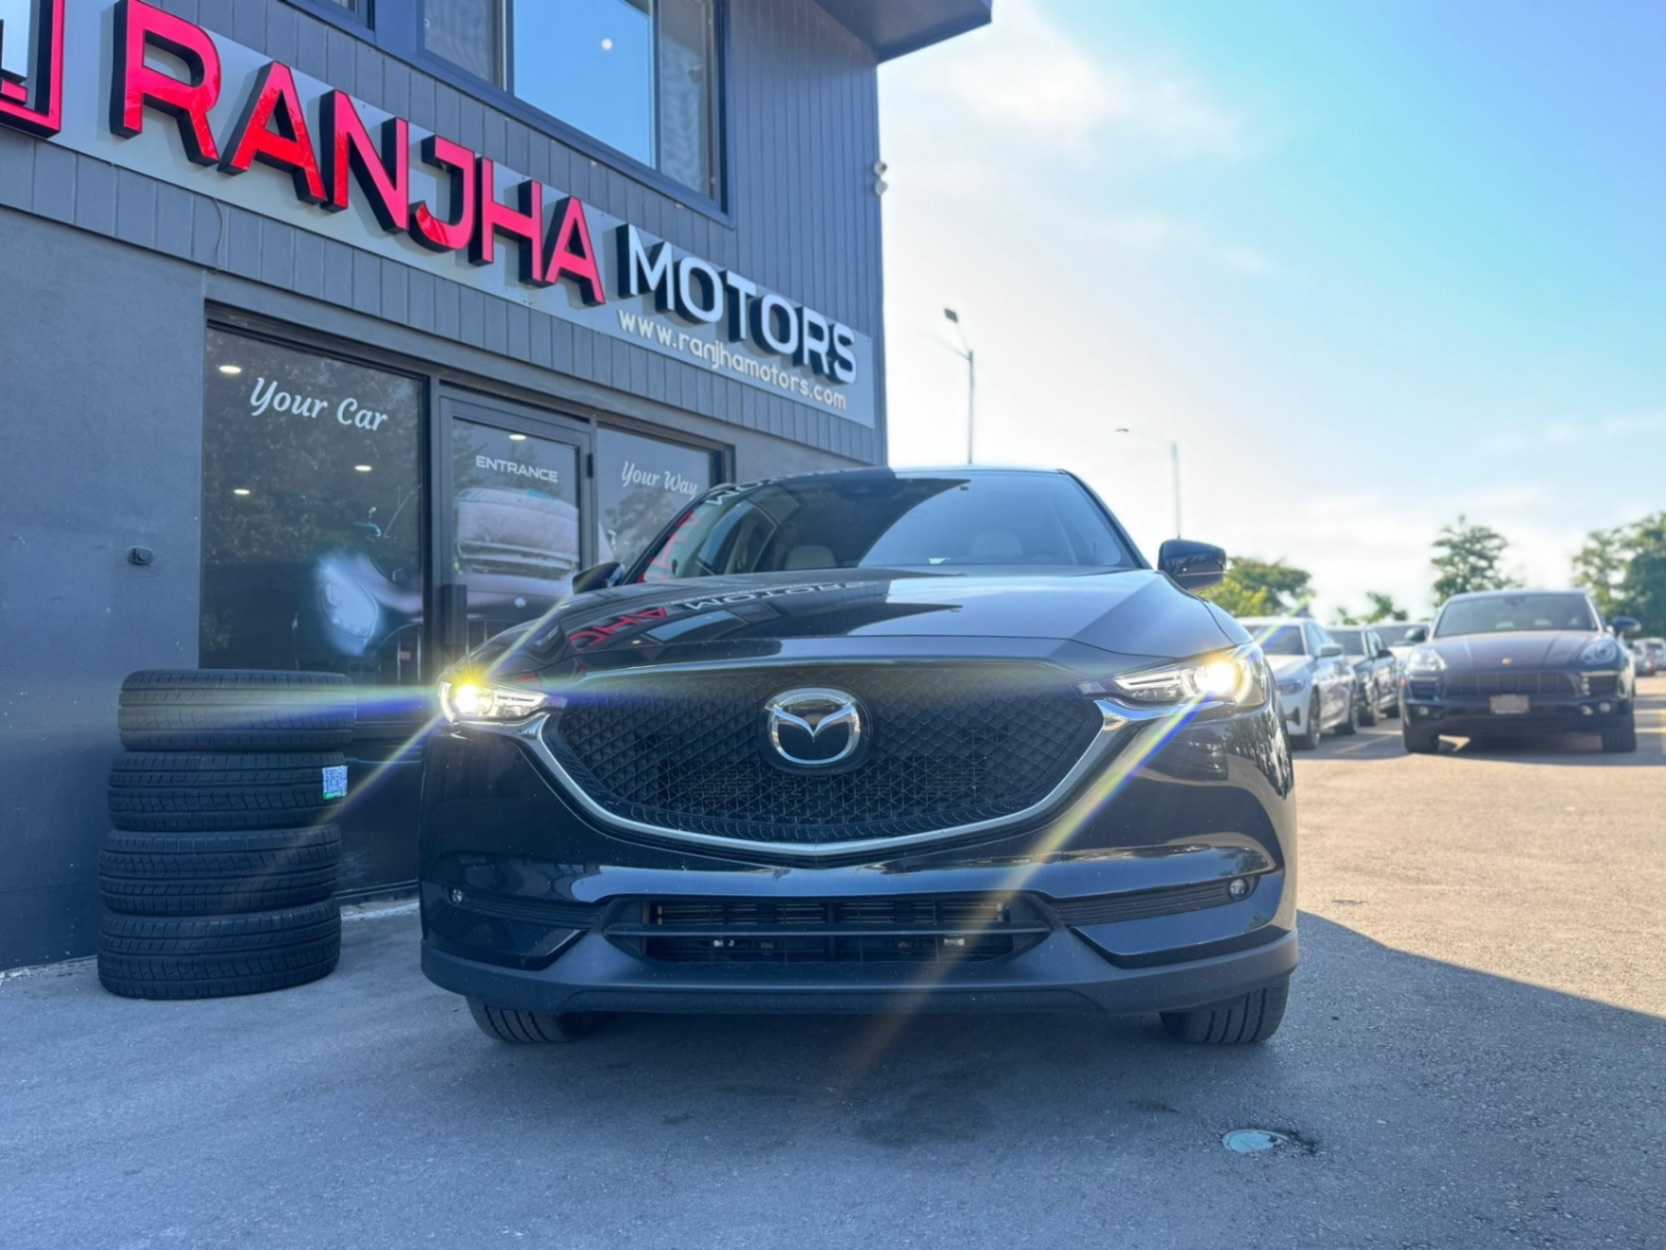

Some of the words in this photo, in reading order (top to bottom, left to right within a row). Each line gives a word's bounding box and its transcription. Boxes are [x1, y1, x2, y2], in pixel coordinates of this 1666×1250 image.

[110, 0, 606, 305] RANJHA
[616, 223, 857, 385] MOTORS
[617, 310, 847, 411] www.ranjhamotors.com
[250, 376, 329, 418] Your
[337, 398, 389, 431] Car
[475, 455, 558, 483] ENTRANCE
[621, 460, 660, 488] Your
[664, 471, 699, 501] Way
